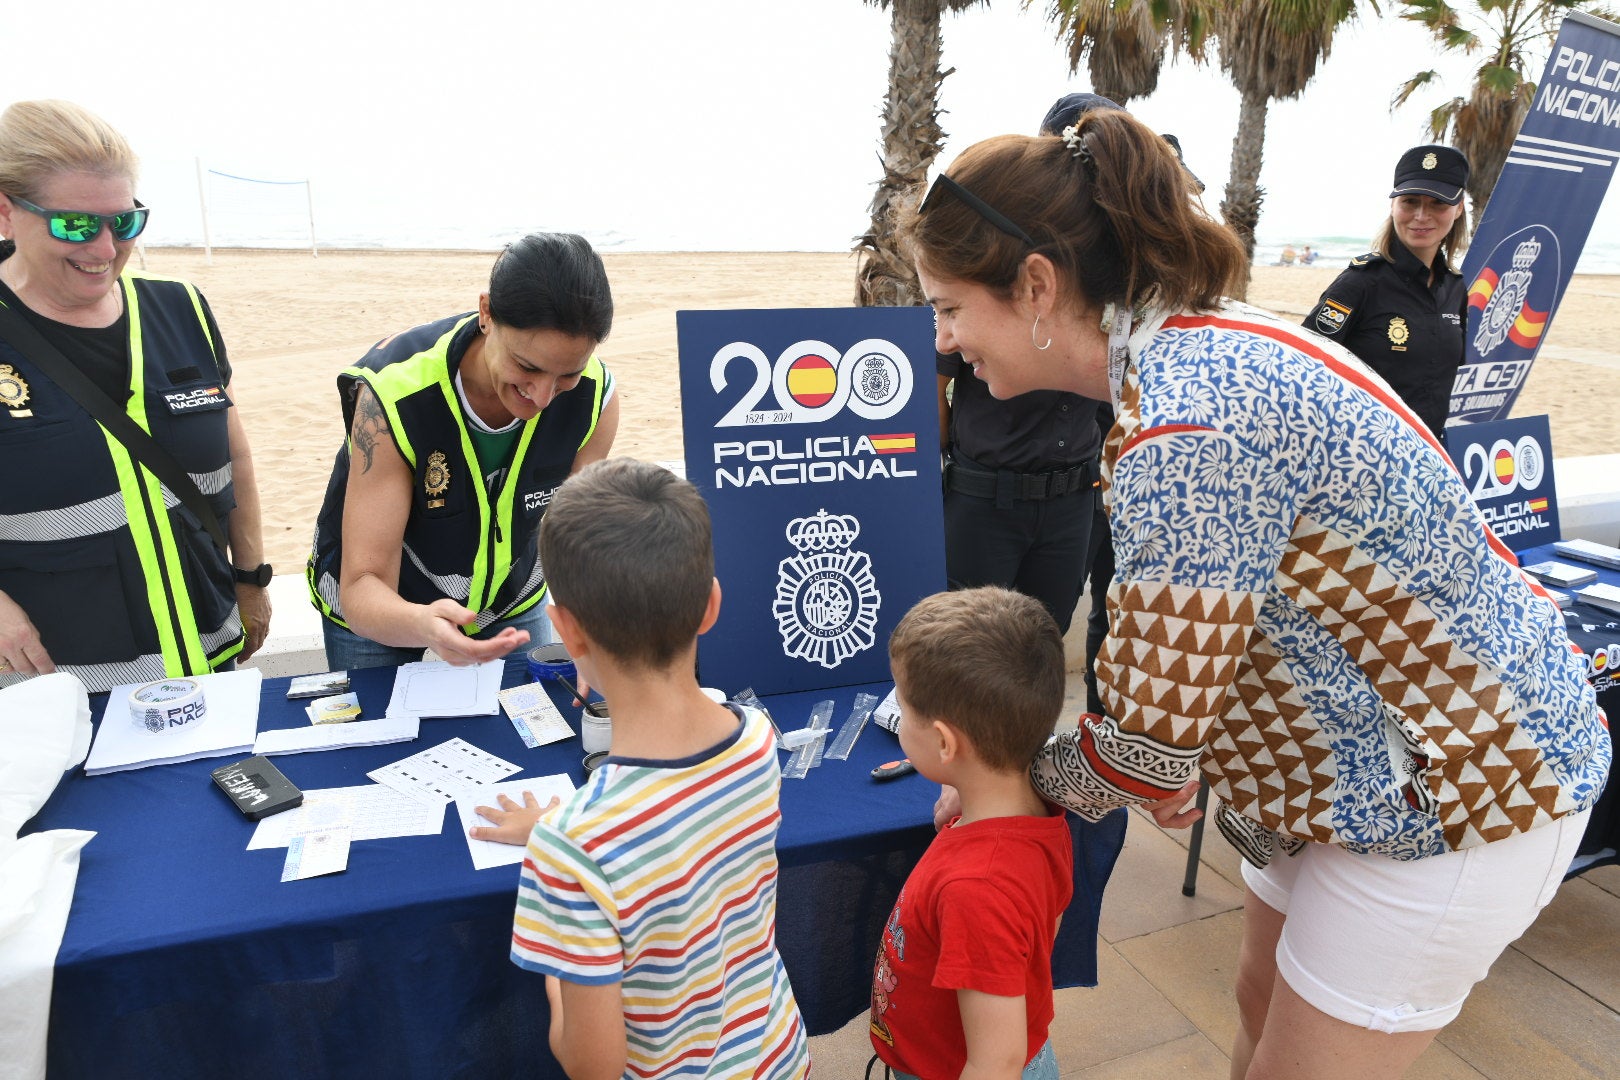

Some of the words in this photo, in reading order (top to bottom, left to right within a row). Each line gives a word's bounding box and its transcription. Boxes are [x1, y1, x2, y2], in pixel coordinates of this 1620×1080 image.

[709, 338, 914, 428] 200
[1483, 363, 1525, 389] 091
[170, 396, 226, 410] NACIONAL
[773, 411, 793, 423] 2024
[715, 457, 918, 489] NACIONAL
[1464, 435, 1545, 501] 200
[1492, 514, 1550, 538] CIONAL
[805, 621, 852, 637] NACIONAL
